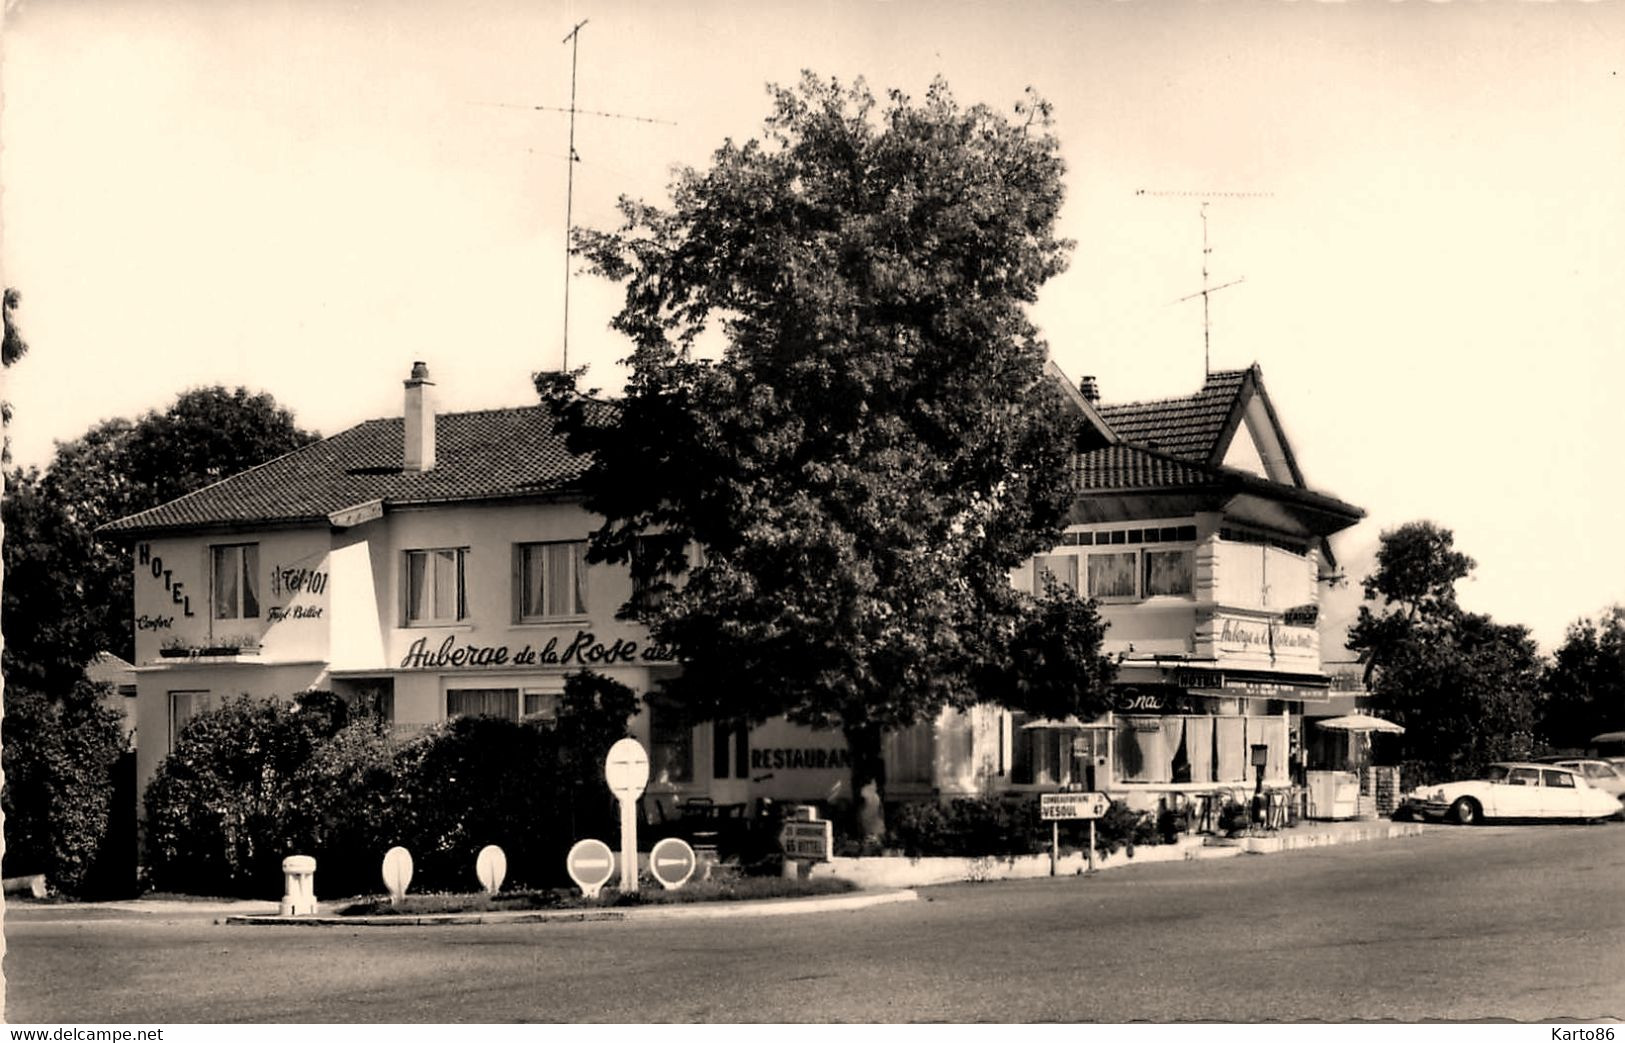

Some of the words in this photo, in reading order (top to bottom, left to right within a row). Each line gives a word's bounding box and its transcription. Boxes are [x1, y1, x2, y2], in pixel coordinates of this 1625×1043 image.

[138, 543, 194, 617] HOTEL
[513, 645, 537, 665] de
[538, 637, 558, 665] la
[561, 631, 637, 665] Rose
[1119, 687, 1171, 710] Snac
[752, 748, 852, 769] RESTAURAN
[1042, 805, 1077, 817] VESOUL
[1093, 804, 1104, 815] 47
